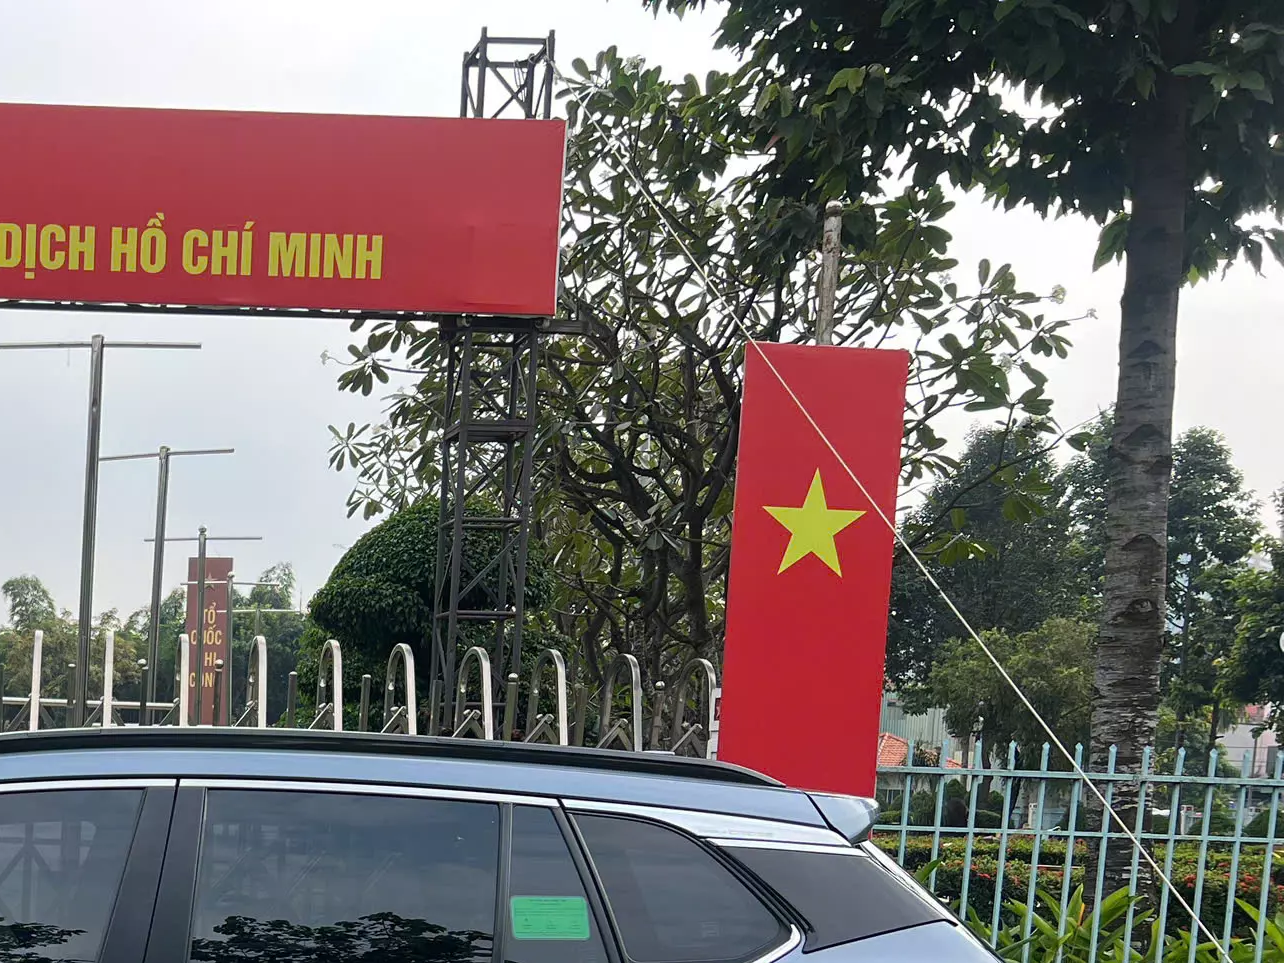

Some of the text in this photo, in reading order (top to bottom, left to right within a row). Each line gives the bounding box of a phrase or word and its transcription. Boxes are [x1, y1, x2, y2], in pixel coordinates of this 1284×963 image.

[110, 211, 168, 275] HỒ
[182, 220, 255, 277] CHÍ
[267, 231, 384, 282] MINH
